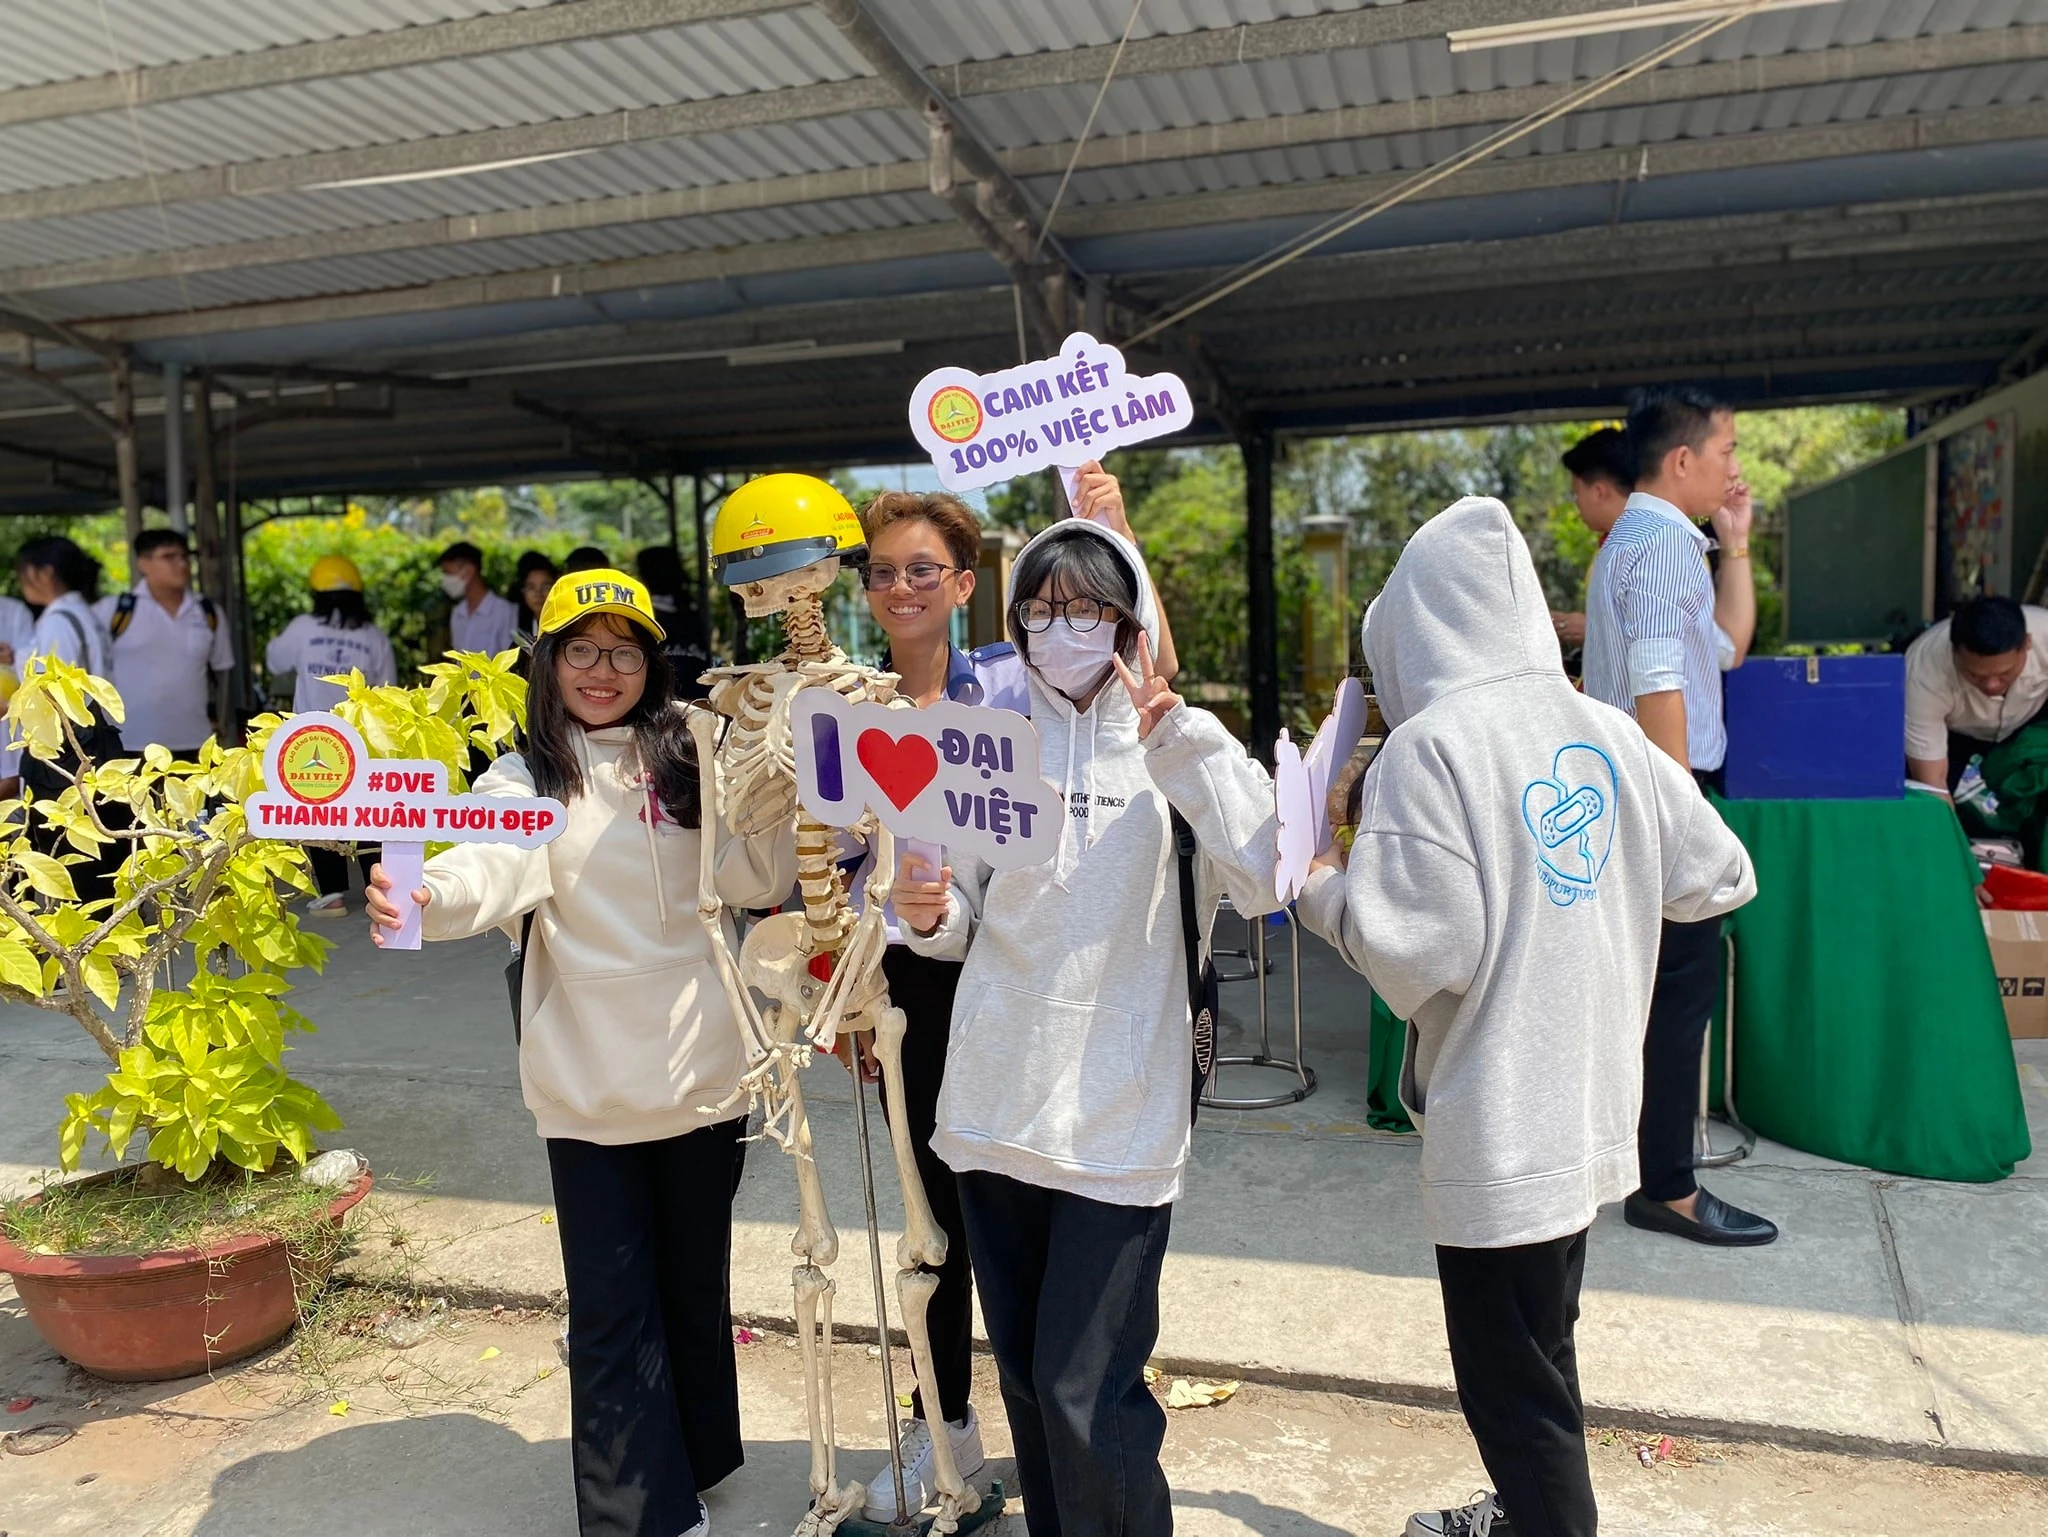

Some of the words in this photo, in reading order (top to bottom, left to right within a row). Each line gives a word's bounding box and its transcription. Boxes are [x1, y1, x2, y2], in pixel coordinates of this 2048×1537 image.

[983, 378, 1053, 418] CAM
[1056, 350, 1109, 399] KẾT
[950, 429, 1038, 474] 100%
[1040, 407, 1110, 447] VIỆC
[1111, 389, 1176, 429] LÀM
[575, 582, 636, 606] UFM
[312, 772, 343, 782] VIỆT
[811, 711, 844, 802] I
[936, 727, 1014, 779] ĐẠI
[367, 772, 435, 793] #DVE
[258, 804, 348, 827] THANH
[354, 801, 426, 828] XUÂN
[433, 806, 495, 829] TƯƠI
[499, 809, 554, 836] ĐẸP
[943, 787, 1038, 845] VIỆT
